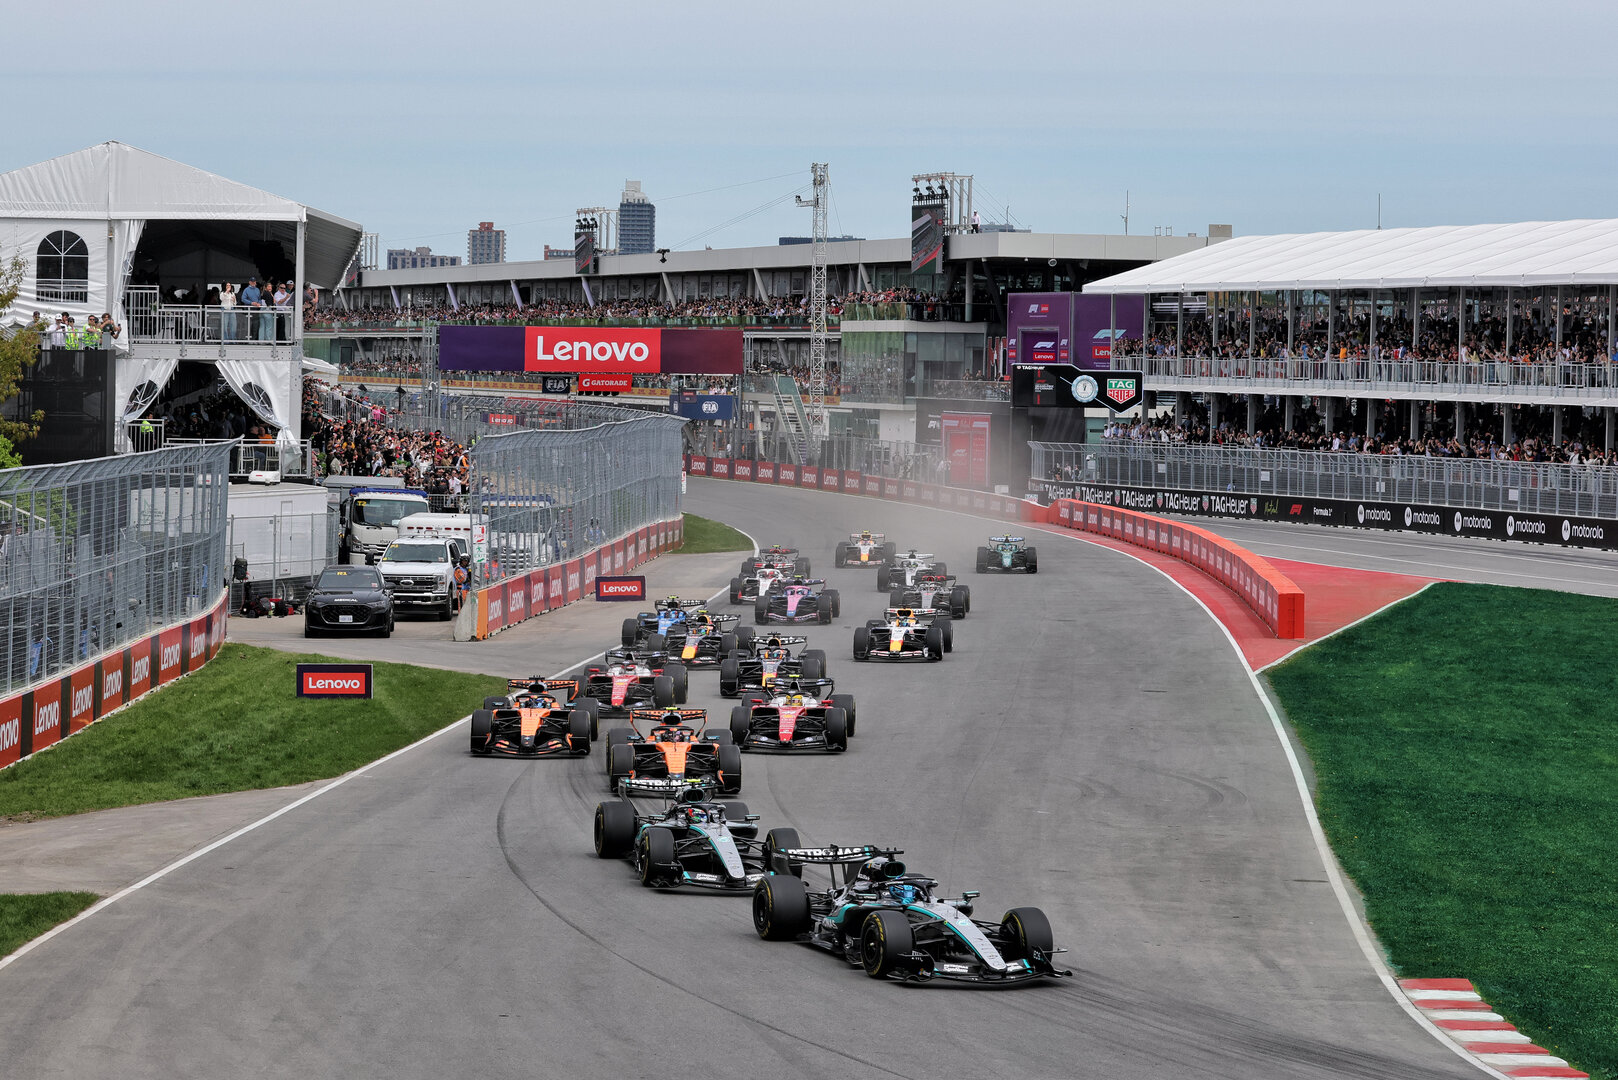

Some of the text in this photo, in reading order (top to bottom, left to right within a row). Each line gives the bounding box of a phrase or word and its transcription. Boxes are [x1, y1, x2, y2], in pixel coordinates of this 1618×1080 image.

[537, 336, 649, 362] Lenovo
[546, 380, 565, 388] FIA
[1108, 390, 1134, 402] HEUER
[692, 460, 705, 471] Lenovo
[713, 462, 727, 473] Lenovo
[736, 464, 750, 476] Lenovo
[758, 466, 773, 478] Lenovo
[780, 468, 794, 480] Lenovo
[802, 470, 816, 483] Lenovo
[824, 472, 837, 486] Lenovo
[1314, 507, 1328, 516] Formula
[1366, 508, 1604, 539] motorola motorola motorola motorola motorola
[191, 632, 206, 659] Lenovo
[161, 643, 180, 671] Lenovo
[132, 656, 149, 686] Lenovo
[104, 669, 121, 700] Lenovo
[308, 677, 360, 689] Lenovo
[72, 684, 92, 718] Lenovo
[35, 700, 59, 735] Lenovo
[0, 718, 19, 750] novo
